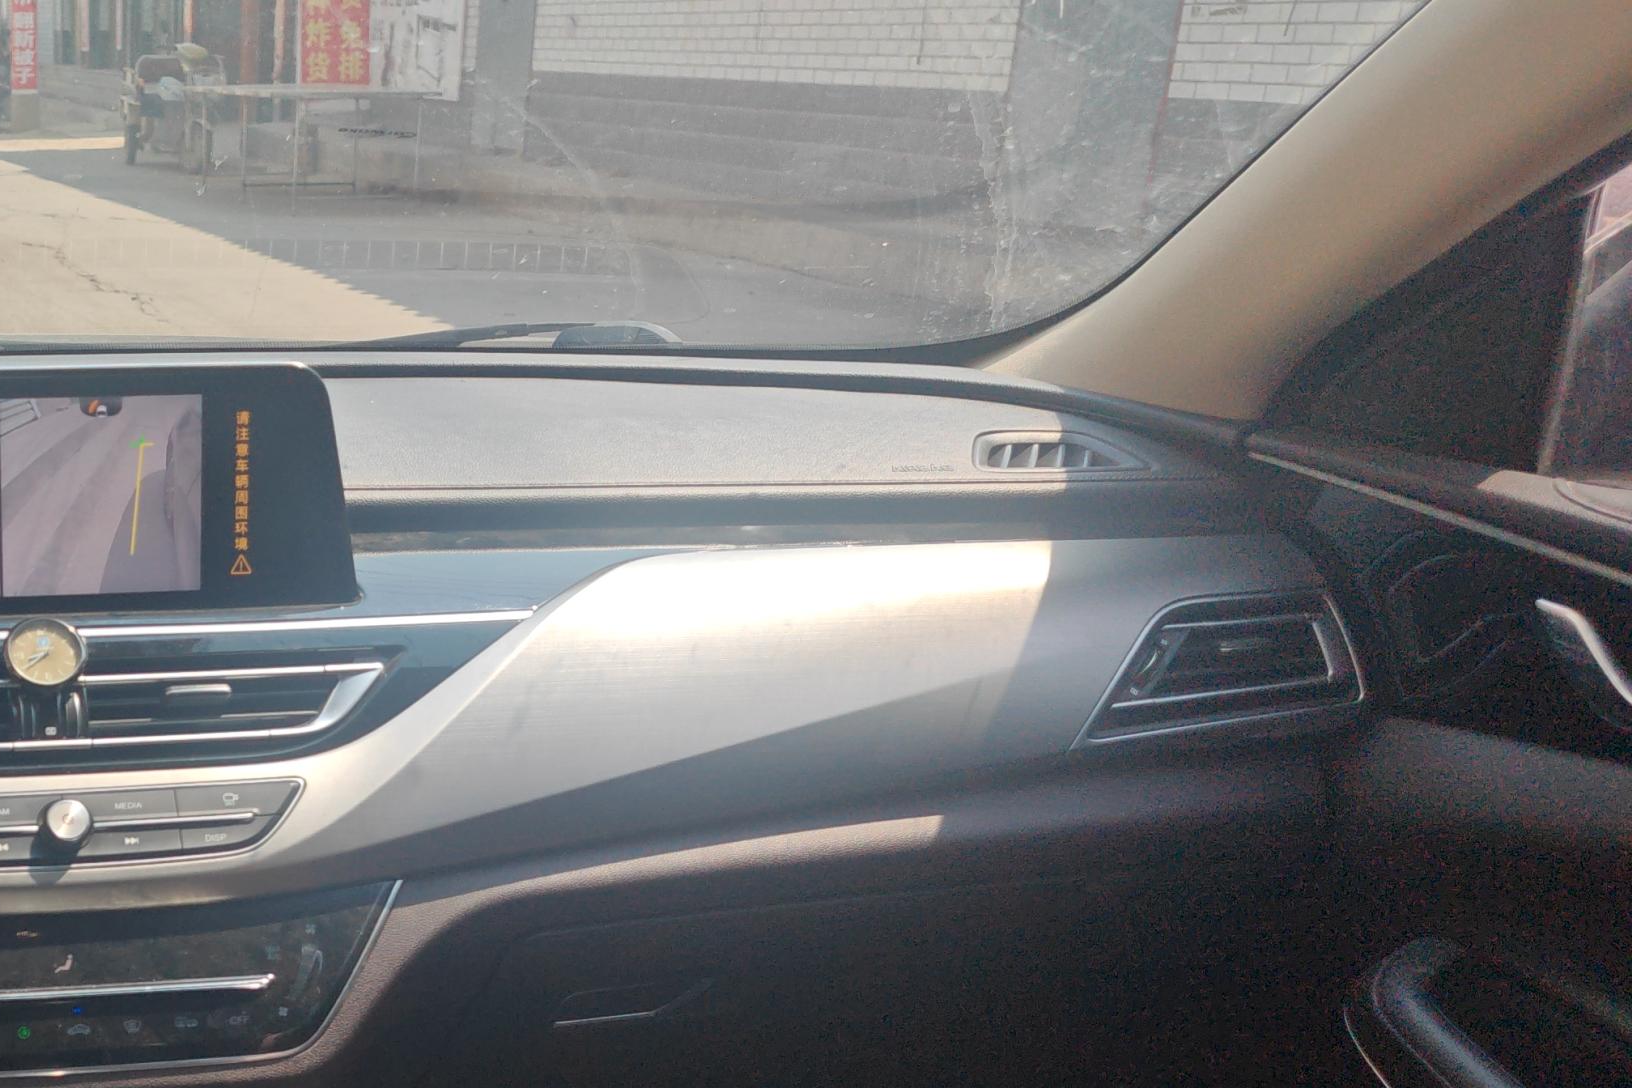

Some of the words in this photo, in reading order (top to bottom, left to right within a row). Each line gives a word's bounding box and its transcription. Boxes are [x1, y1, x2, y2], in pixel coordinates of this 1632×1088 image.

[235, 411, 251, 550] 请注意车辆周围环境
[114, 801, 143, 810] MEDIA
[204, 833, 227, 842] DISP
